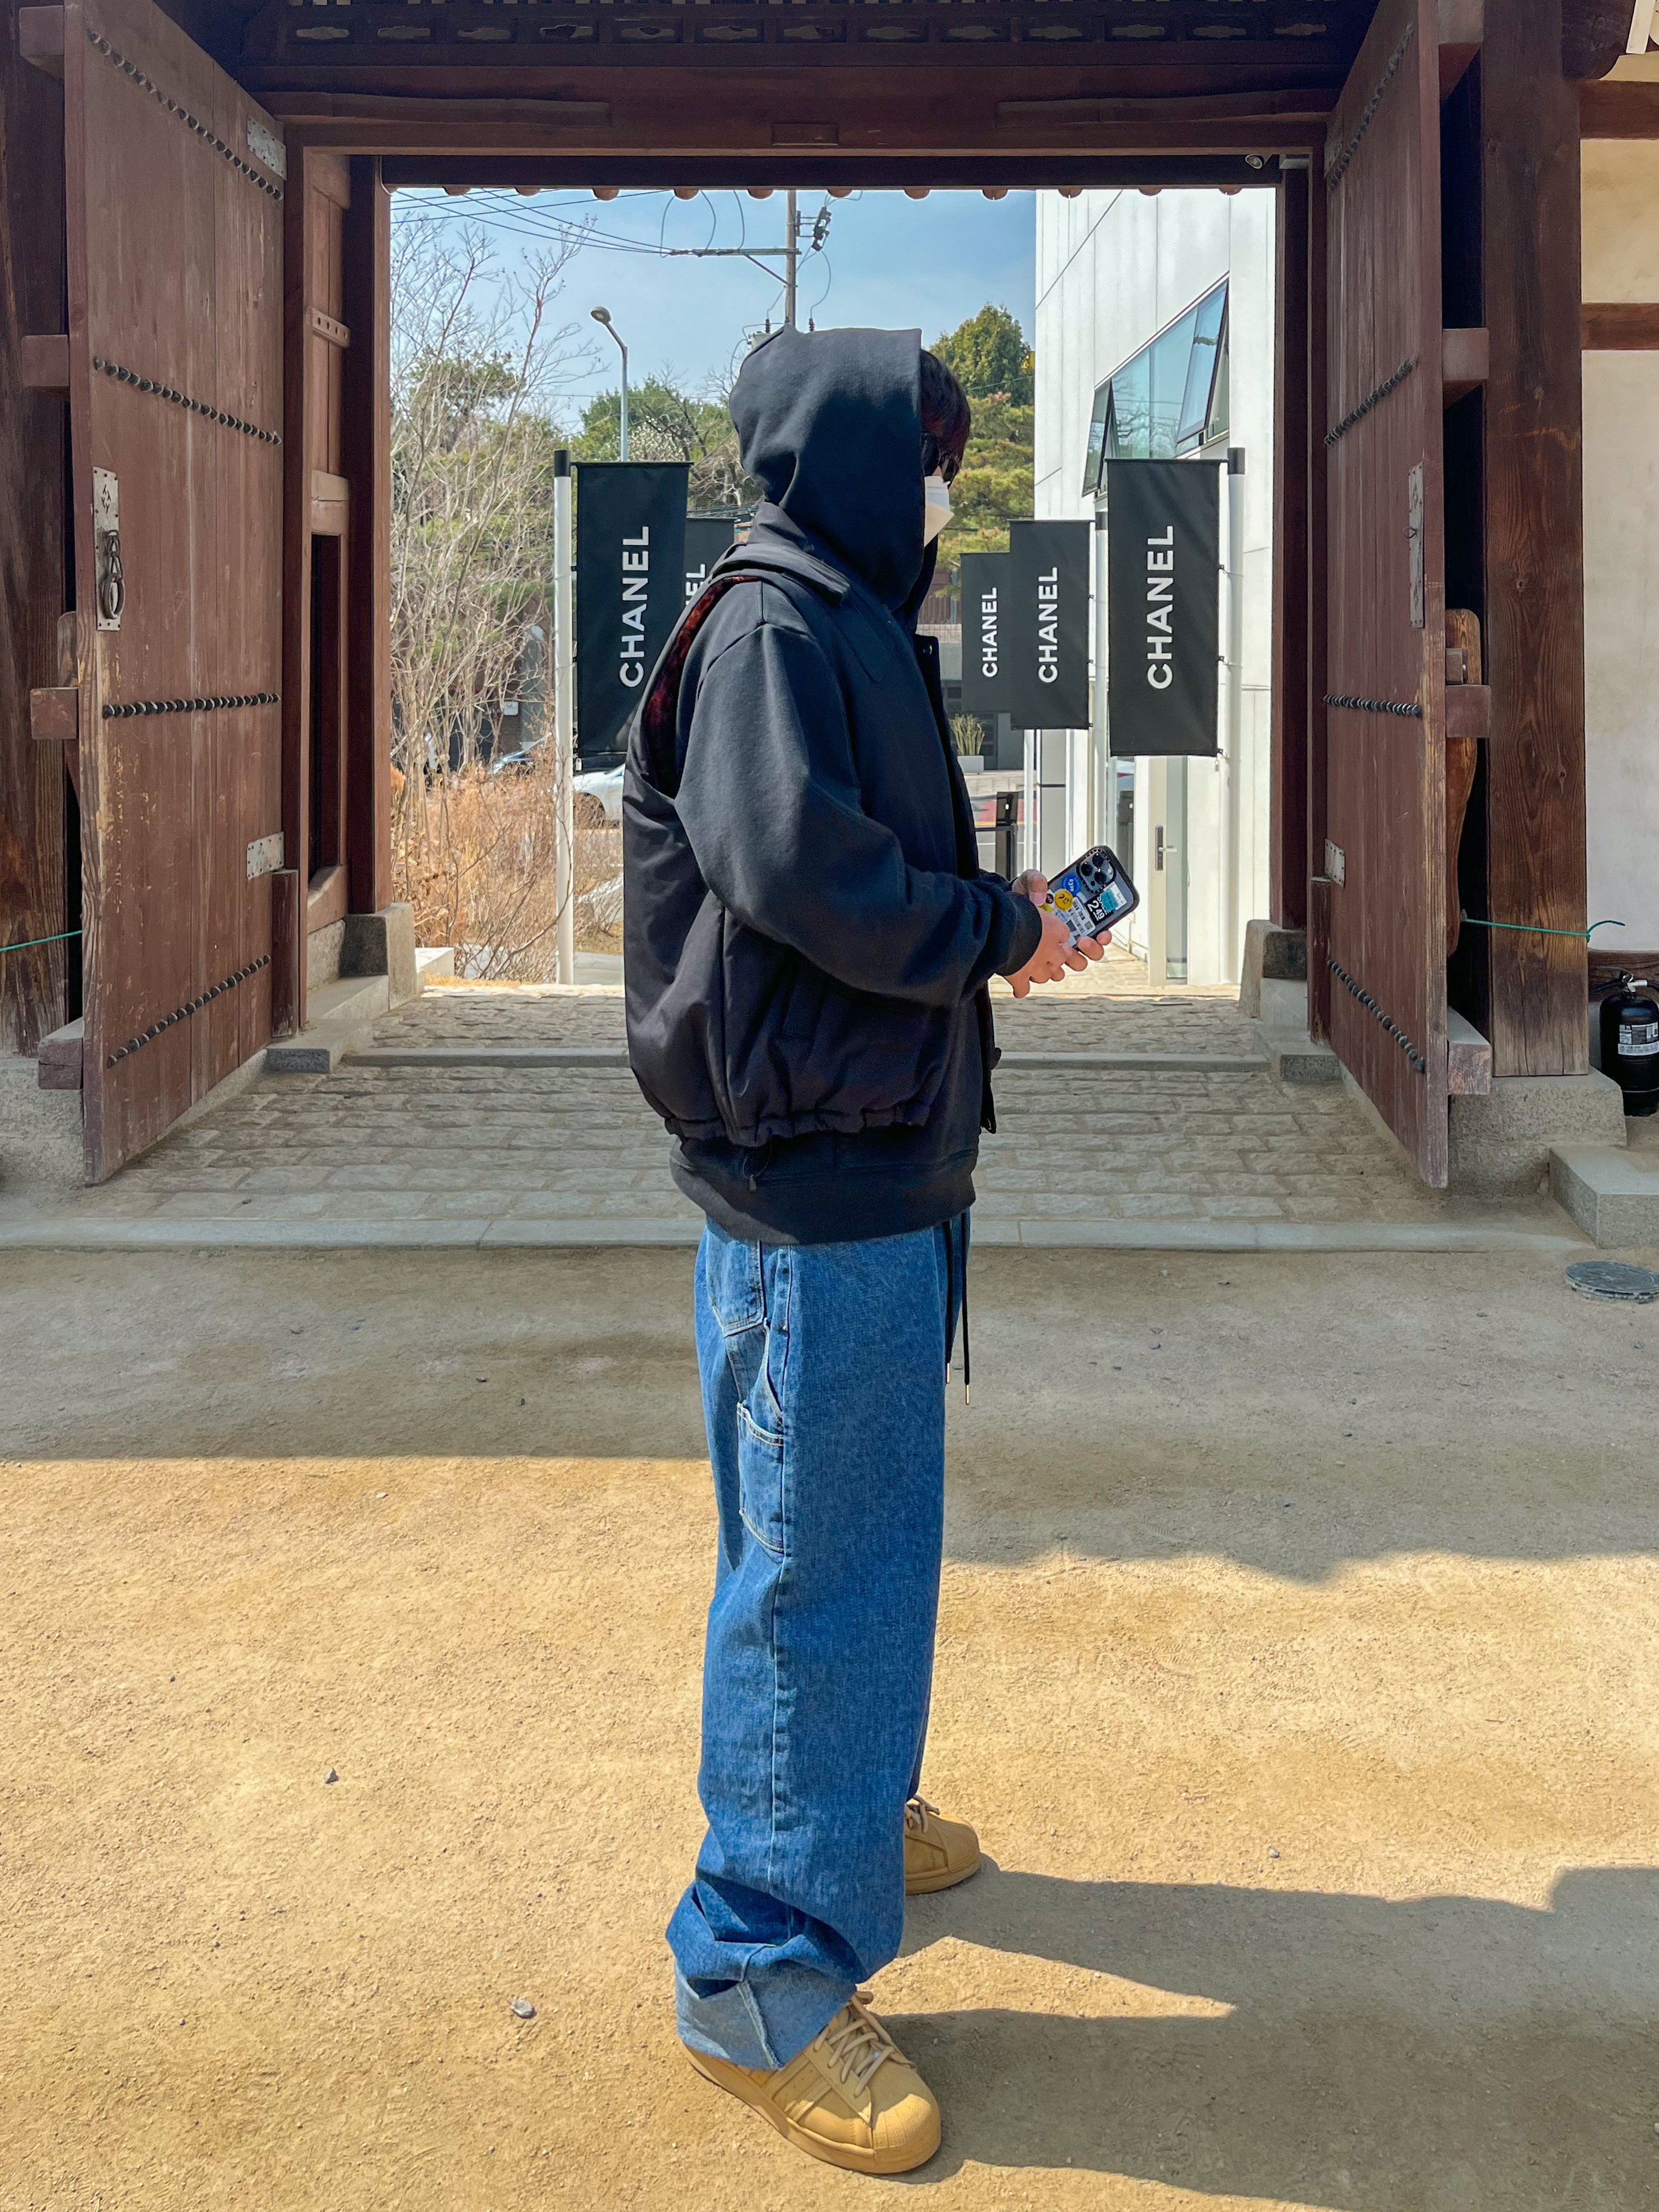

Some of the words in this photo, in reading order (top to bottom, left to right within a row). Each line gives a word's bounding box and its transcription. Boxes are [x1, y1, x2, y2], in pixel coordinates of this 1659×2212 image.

[619, 526, 649, 688] CHANEL
[685, 564, 706, 605] EL
[981, 587, 998, 678] CHANEL
[1038, 567, 1058, 683] CHANEL
[1147, 525, 1174, 689] CHANEL
